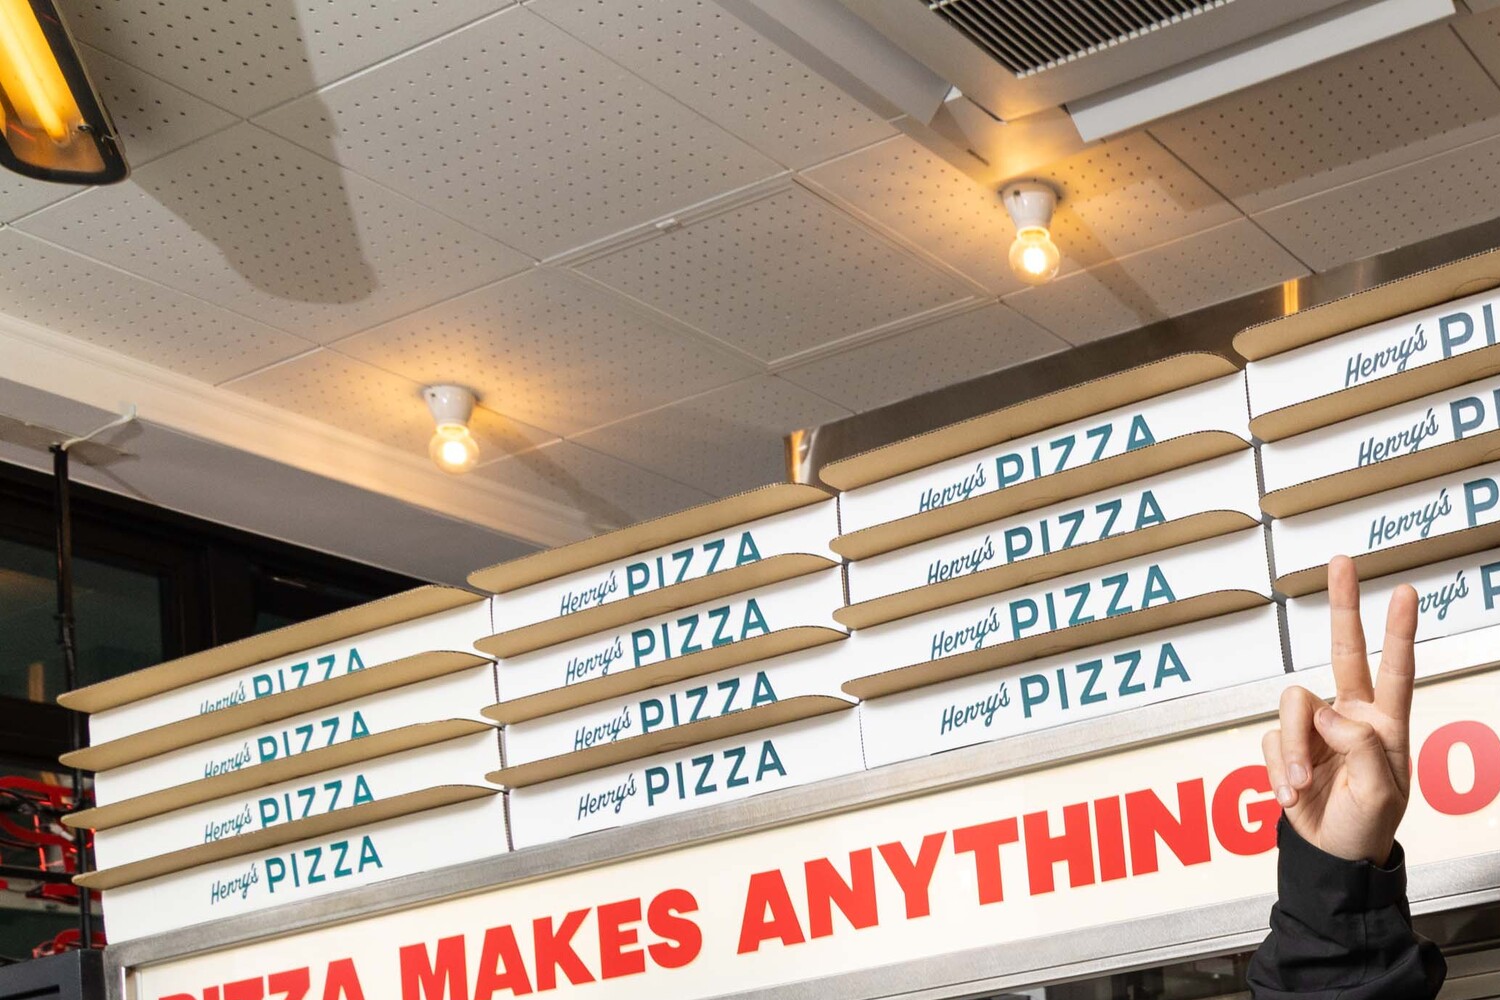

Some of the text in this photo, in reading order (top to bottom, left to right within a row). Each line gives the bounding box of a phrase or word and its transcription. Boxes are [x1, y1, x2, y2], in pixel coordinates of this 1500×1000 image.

[1344, 323, 1428, 387] Henry's
[918, 414, 1156, 513] Henry's PIZZA
[1357, 408, 1439, 467] Henry's
[927, 489, 1167, 585] Henry's PIZZA
[1368, 487, 1452, 549] Henry's
[560, 531, 763, 616] Henry's PIZZA
[930, 564, 1177, 661] Henry's PIZZA
[1417, 570, 1469, 621] nry's
[252, 648, 366, 700] PIZZA
[565, 598, 770, 686] Henry's PIZZA
[574, 670, 778, 750] Henry's PIZZA
[940, 642, 1191, 736] Henry's PIZZA
[204, 710, 371, 778] Henry's PIZZA
[577, 739, 787, 820] Henry's PIZZA
[204, 774, 374, 843] Henry's PIZZA
[211, 835, 384, 905] Henry's PIZZA
[736, 764, 1281, 955] ANYTHING
